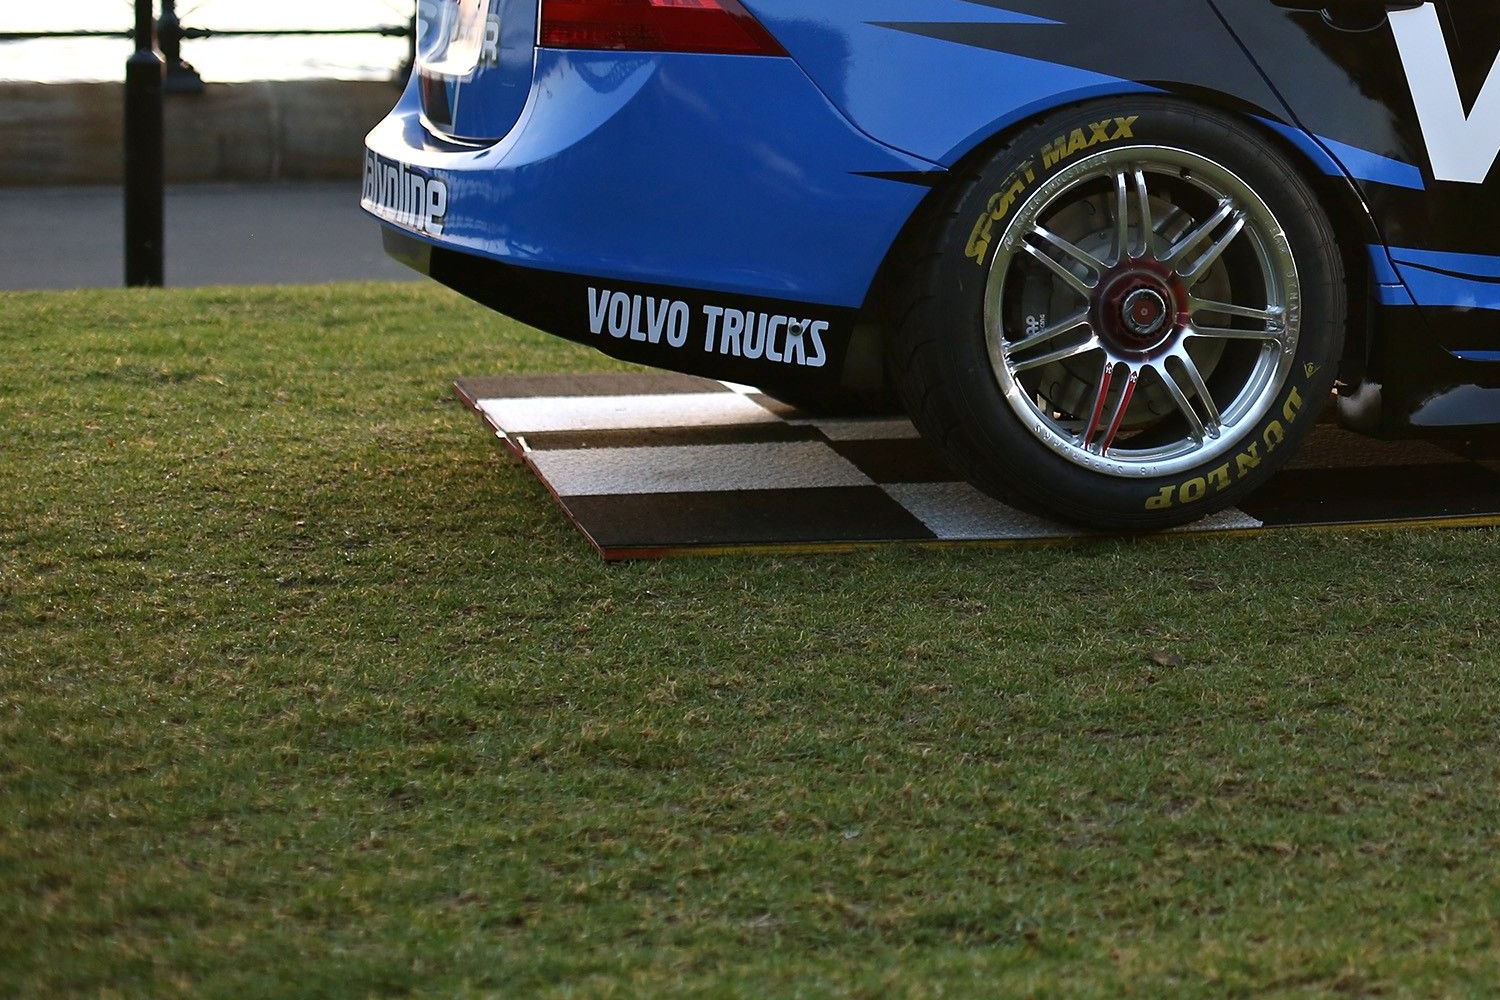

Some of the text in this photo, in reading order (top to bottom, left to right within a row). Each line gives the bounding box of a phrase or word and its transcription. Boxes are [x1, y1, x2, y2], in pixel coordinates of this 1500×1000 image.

[1041, 115, 1139, 170] MAXX
[587, 287, 830, 368] VOLVO TRUCKS
[1144, 386, 1304, 511] DUNLOP
